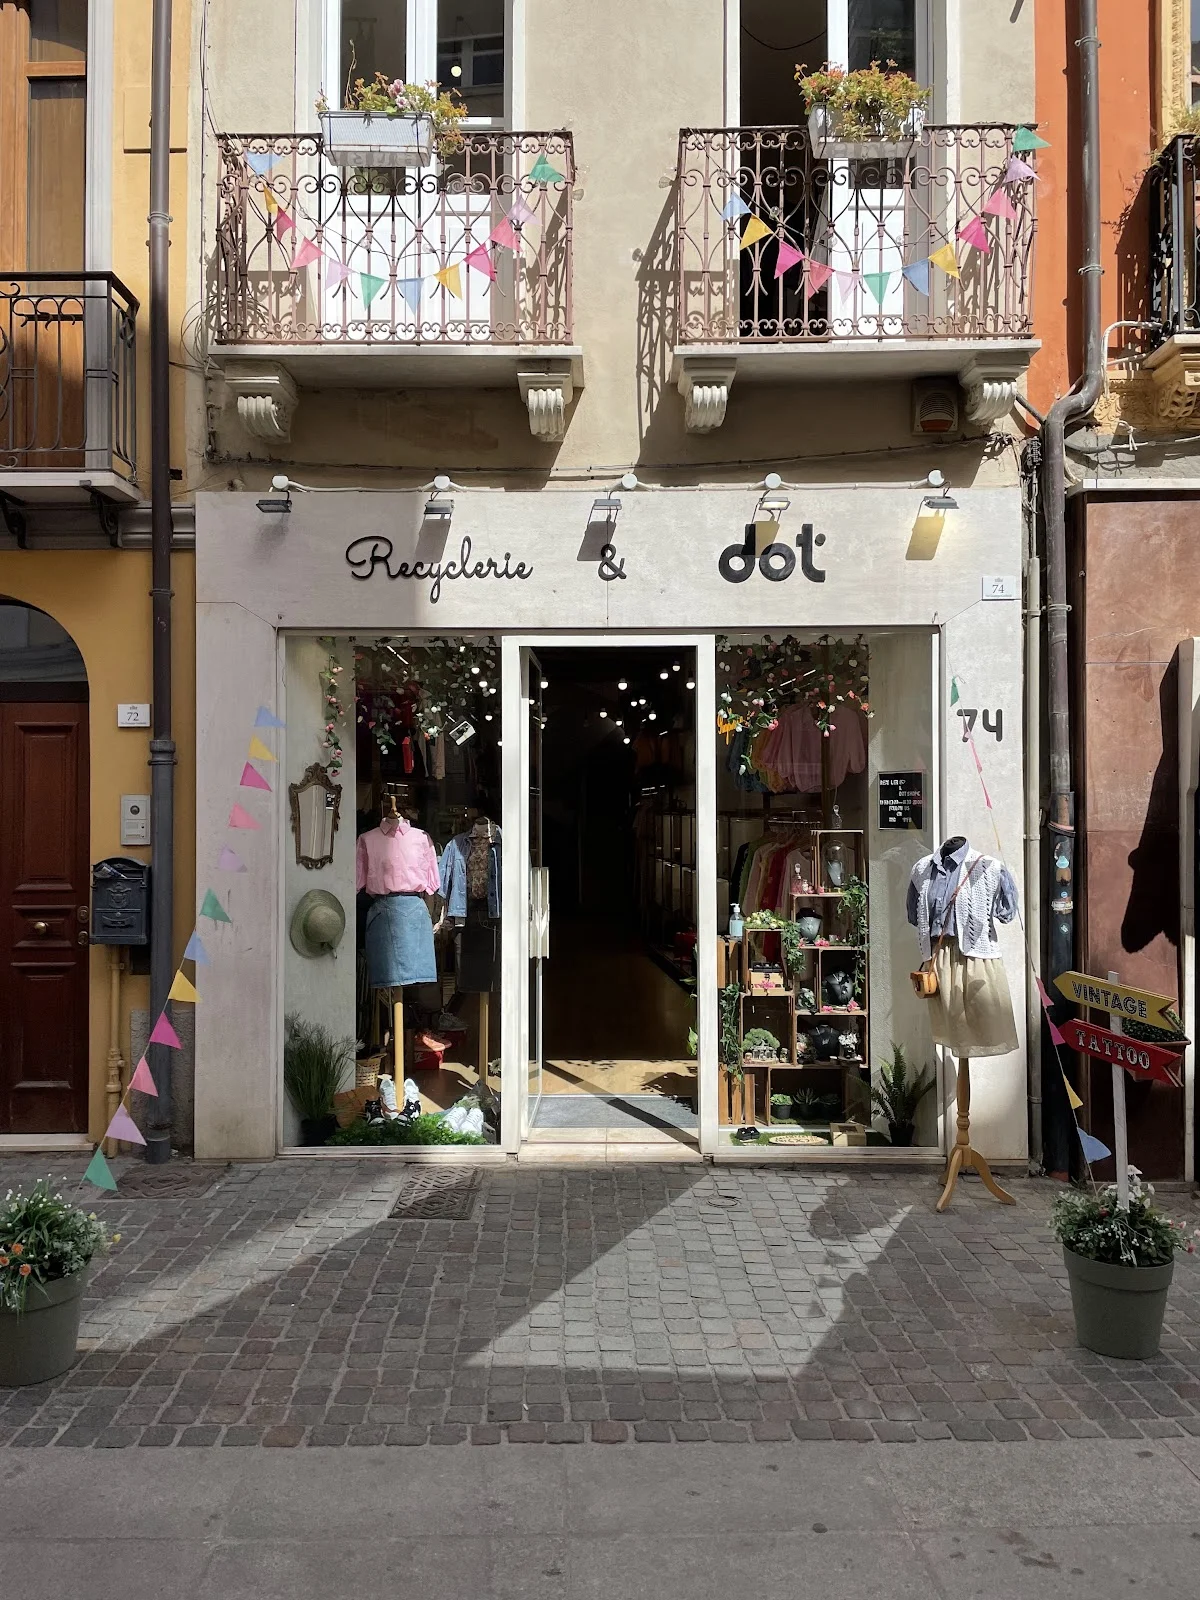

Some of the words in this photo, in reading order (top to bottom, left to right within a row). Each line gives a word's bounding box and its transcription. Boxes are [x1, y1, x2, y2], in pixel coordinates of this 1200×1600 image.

[345, 535, 533, 604] Recyclerie
[598, 543, 627, 580] &
[718, 523, 827, 583] dot
[992, 584, 1004, 593] 74
[127, 711, 139, 721] 72
[956, 708, 1003, 742] 74
[1071, 980, 1147, 1018] VINTAGE
[1075, 1029, 1150, 1070] TATTOO
